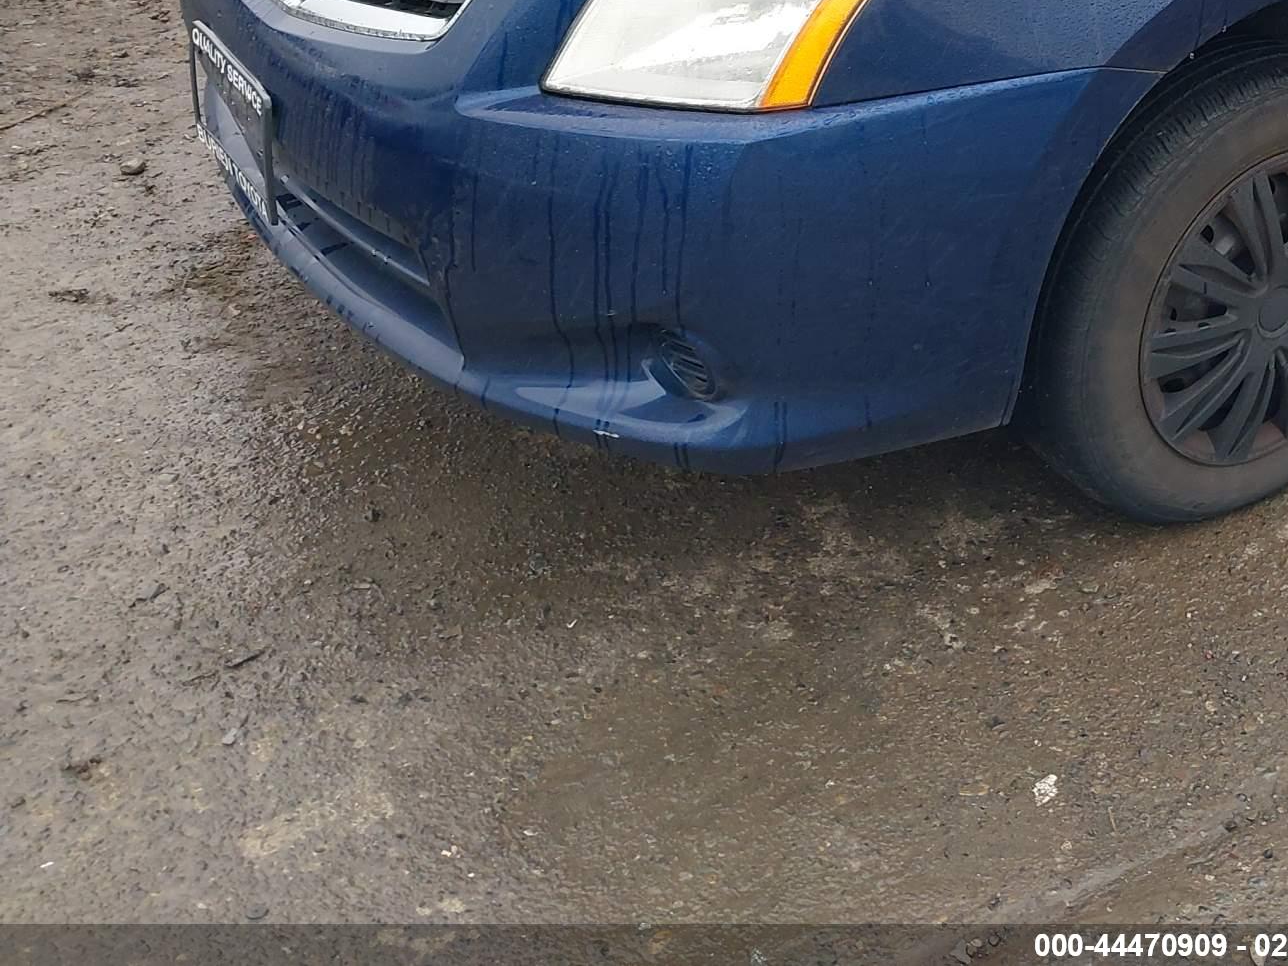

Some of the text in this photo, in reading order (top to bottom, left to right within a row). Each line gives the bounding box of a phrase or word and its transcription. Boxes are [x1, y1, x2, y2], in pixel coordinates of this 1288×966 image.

[192, 28, 262, 116] QUALITY SERVICE
[232, 163, 269, 224] TOYOTA
